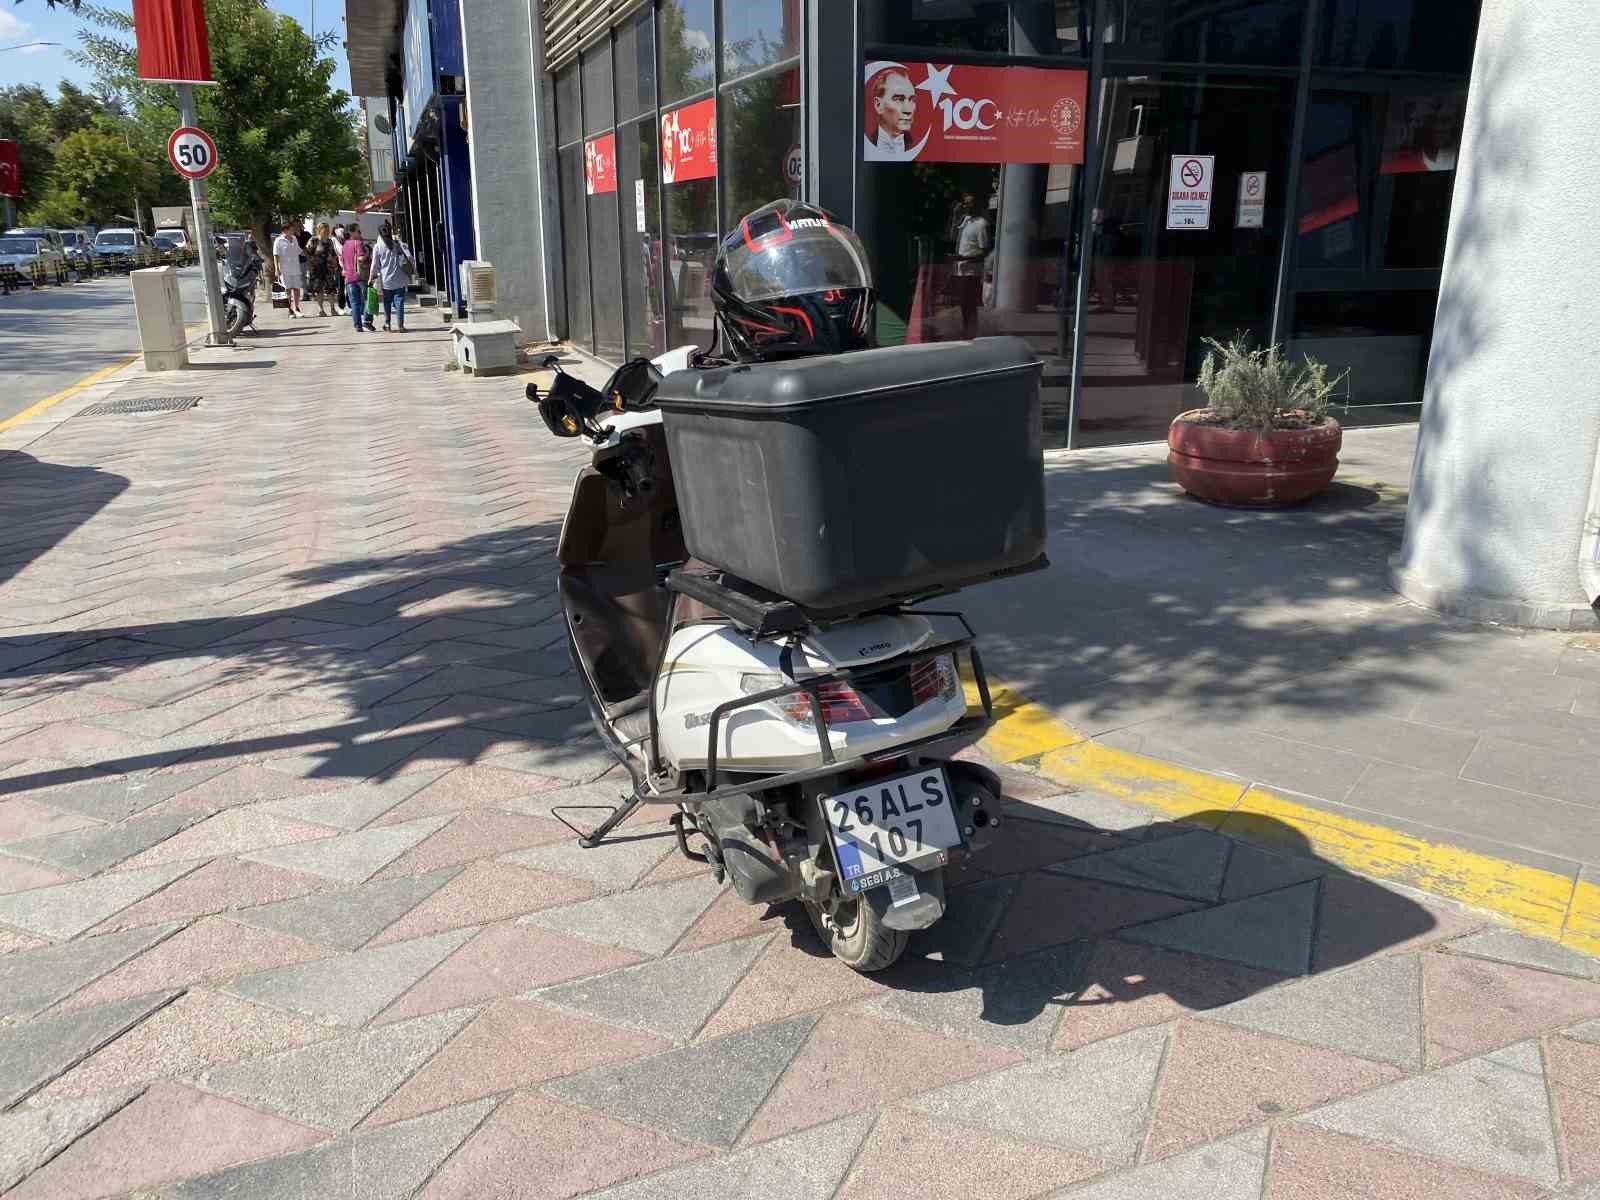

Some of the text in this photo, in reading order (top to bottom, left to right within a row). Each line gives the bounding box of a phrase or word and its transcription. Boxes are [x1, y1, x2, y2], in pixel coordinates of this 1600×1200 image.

[178, 144, 207, 166] 50
[833, 776, 943, 833] 26 ALS
[870, 818, 923, 862] 107
[846, 863, 862, 876] TR
